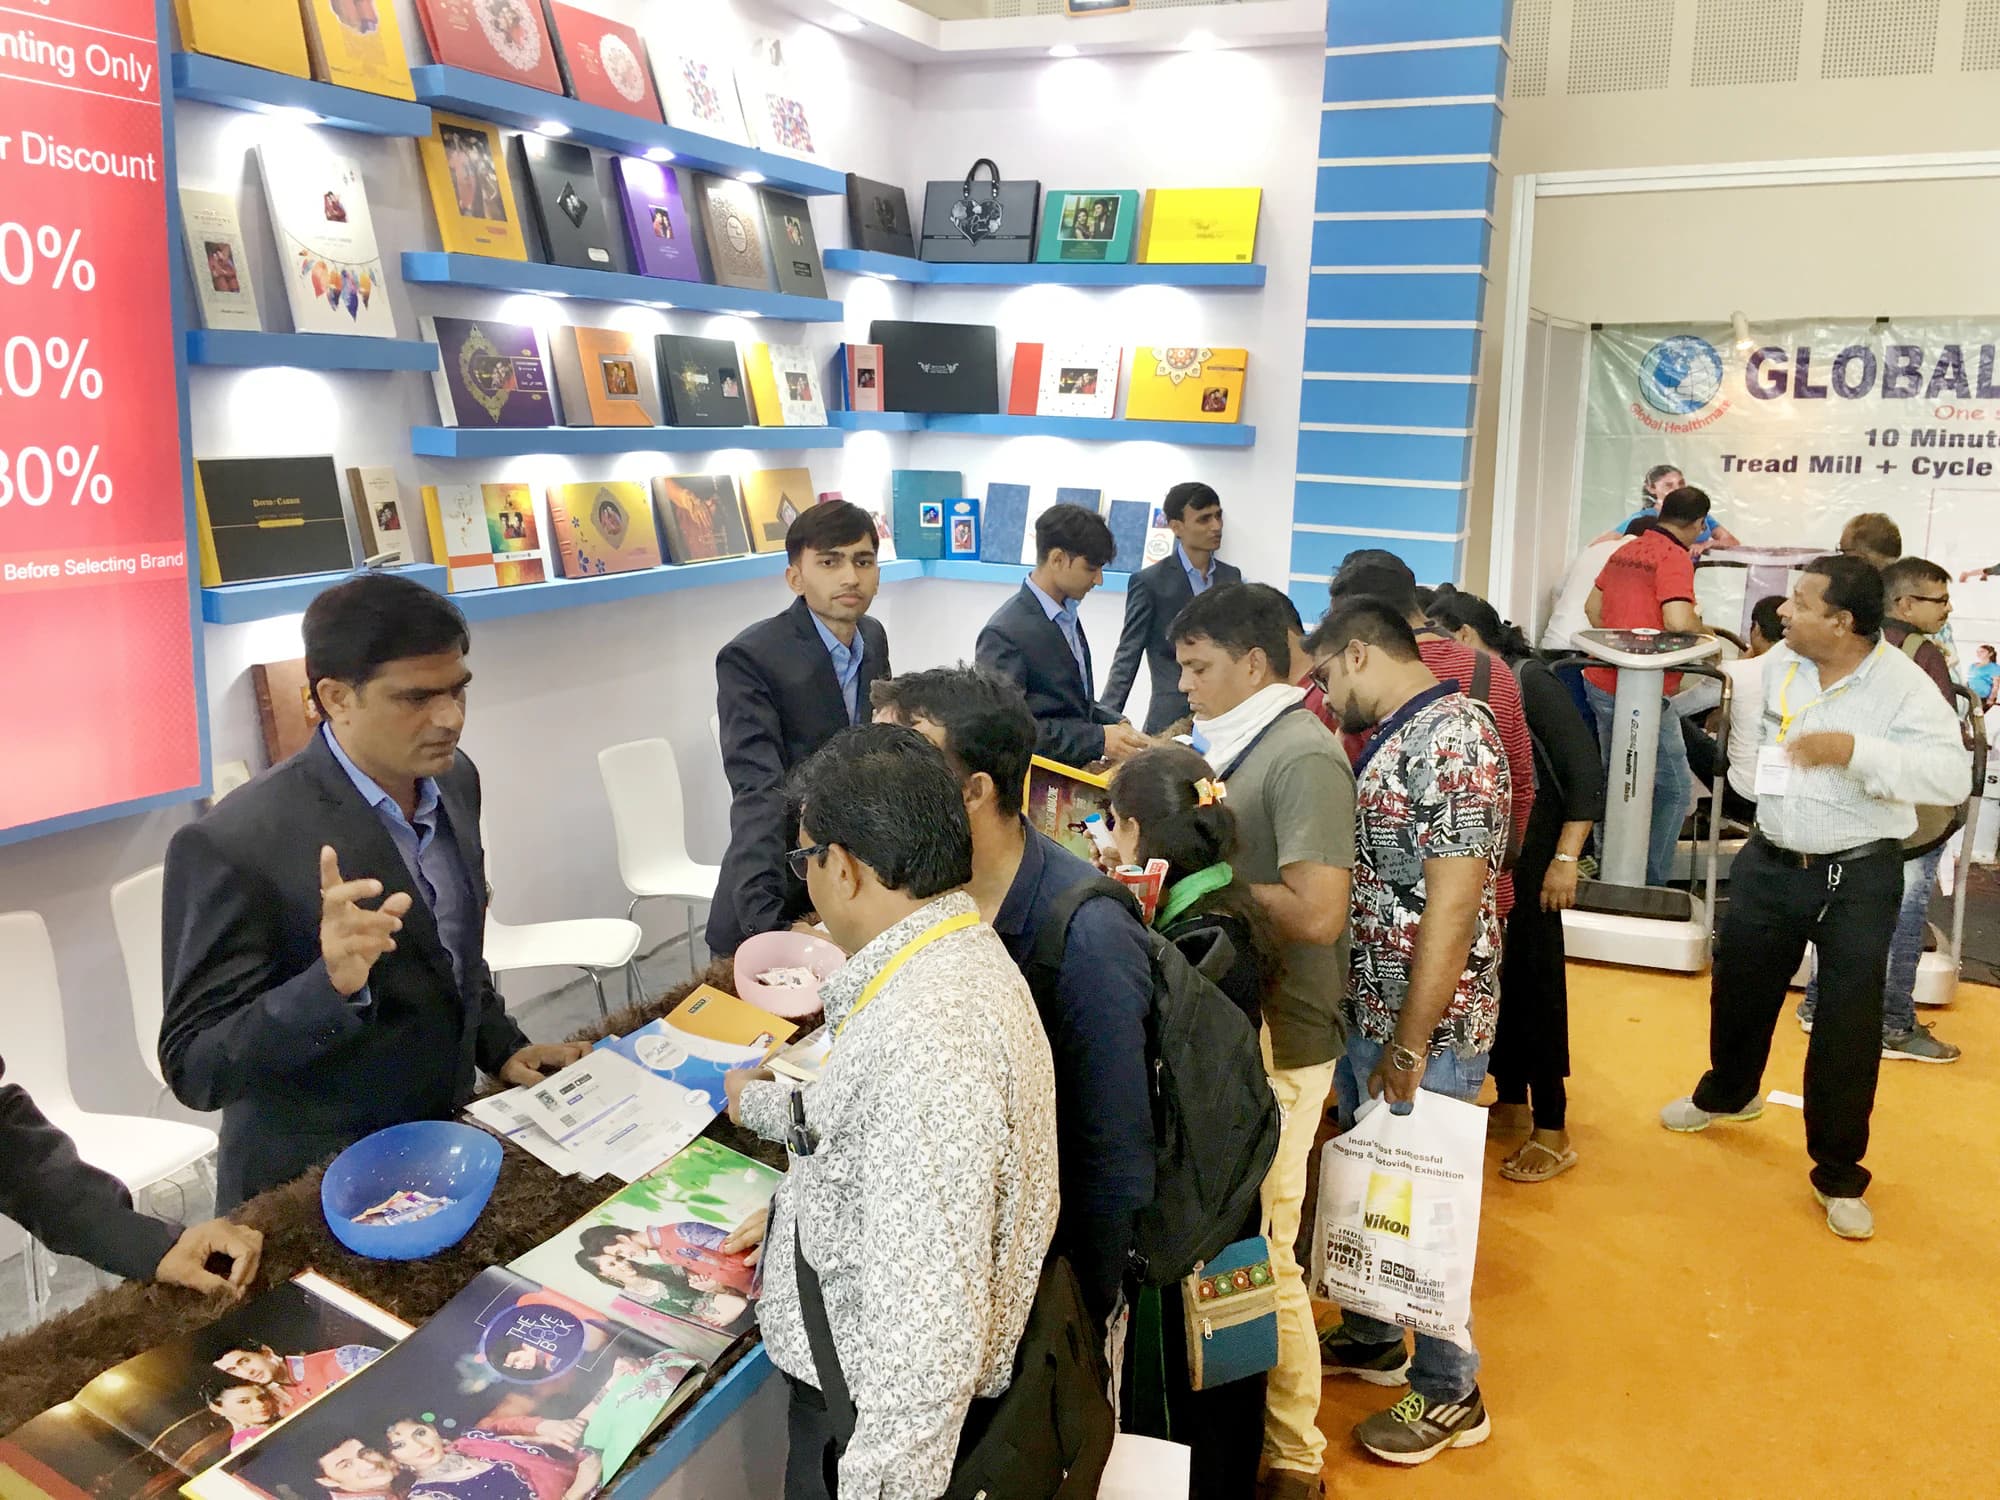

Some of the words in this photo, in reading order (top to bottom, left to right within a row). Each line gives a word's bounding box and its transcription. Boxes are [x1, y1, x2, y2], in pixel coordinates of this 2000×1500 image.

[85, 44, 152, 92] Only
[21, 131, 157, 182] Discount
[0, 336, 103, 399] 0%
[1745, 344, 2000, 400] GLOBAL
[1631, 403, 1663, 431] Global
[1934, 404, 1985, 421] One
[1864, 428, 1900, 447] 10
[1910, 428, 2000, 448] Minut
[1720, 454, 1798, 474] Tread
[1808, 455, 1862, 474] Mill
[1911, 456, 1993, 479] Cycle
[4, 564, 60, 581] Before
[64, 556, 137, 574] Selecting
[140, 552, 184, 569] Brand
[1348, 1136, 1379, 1149] India's
[1414, 1165, 1465, 1180] Exhibition
[1363, 1211, 1410, 1238] Nikon
[505, 1315, 537, 1338] THE
[523, 1313, 560, 1346] LOVE
[539, 1319, 576, 1352] BOOK
